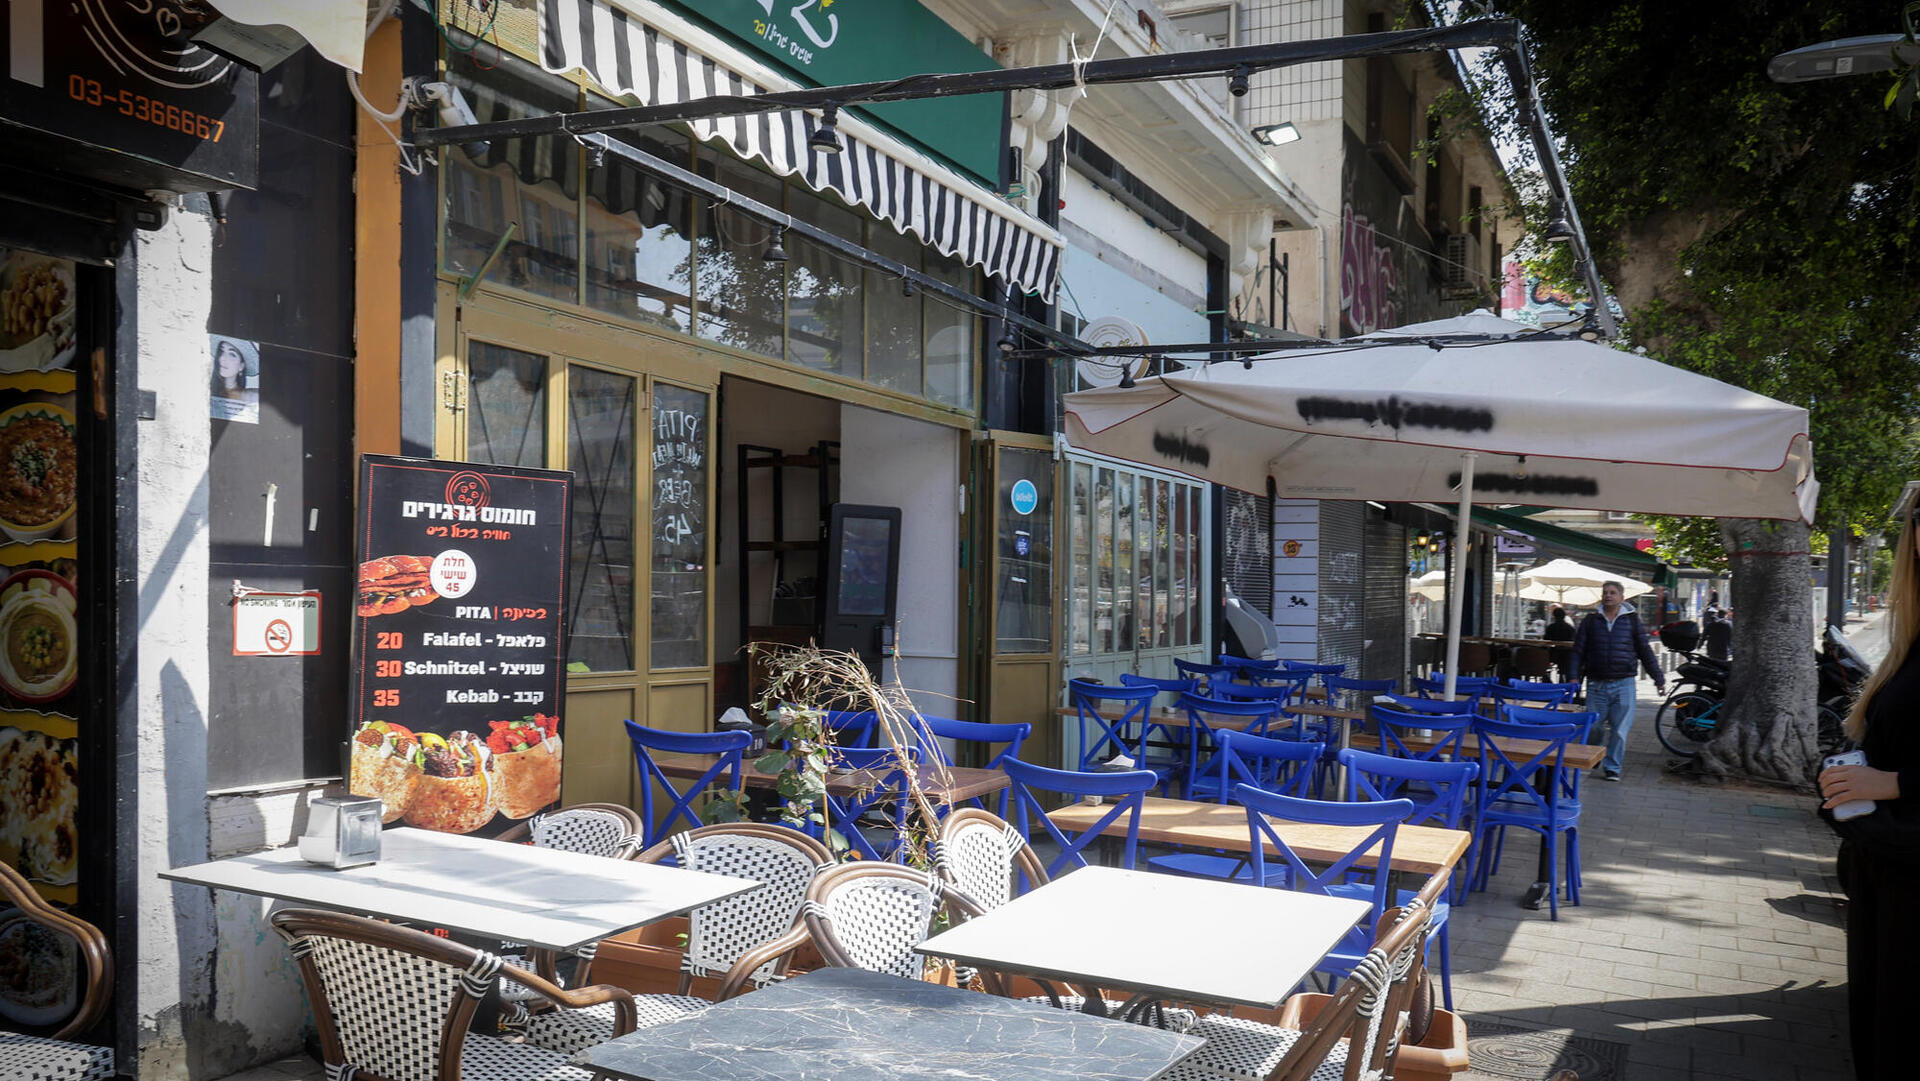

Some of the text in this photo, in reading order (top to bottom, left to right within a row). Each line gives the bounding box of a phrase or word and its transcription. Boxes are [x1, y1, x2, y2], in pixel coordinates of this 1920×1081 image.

[69, 74, 225, 143] 03-5366667
[402, 501, 536, 525] חומוס גרגירים
[425, 526, 448, 537] ביס
[482, 529, 511, 541] חוויה
[443, 557, 465, 567] חלת
[440, 570, 466, 580] שישי
[445, 583, 460, 592] 45
[455, 605, 492, 619] PITA
[502, 607, 548, 622] בפיתה
[376, 632, 404, 649] 20
[423, 632, 482, 647] Falafel
[496, 634, 546, 648] פלאפל
[375, 660, 402, 678] 30
[404, 661, 486, 676] Schnitzel
[500, 662, 545, 676] שניצל
[373, 689, 400, 707] 35
[446, 689, 499, 704] Kebab
[513, 690, 544, 705] קבב
